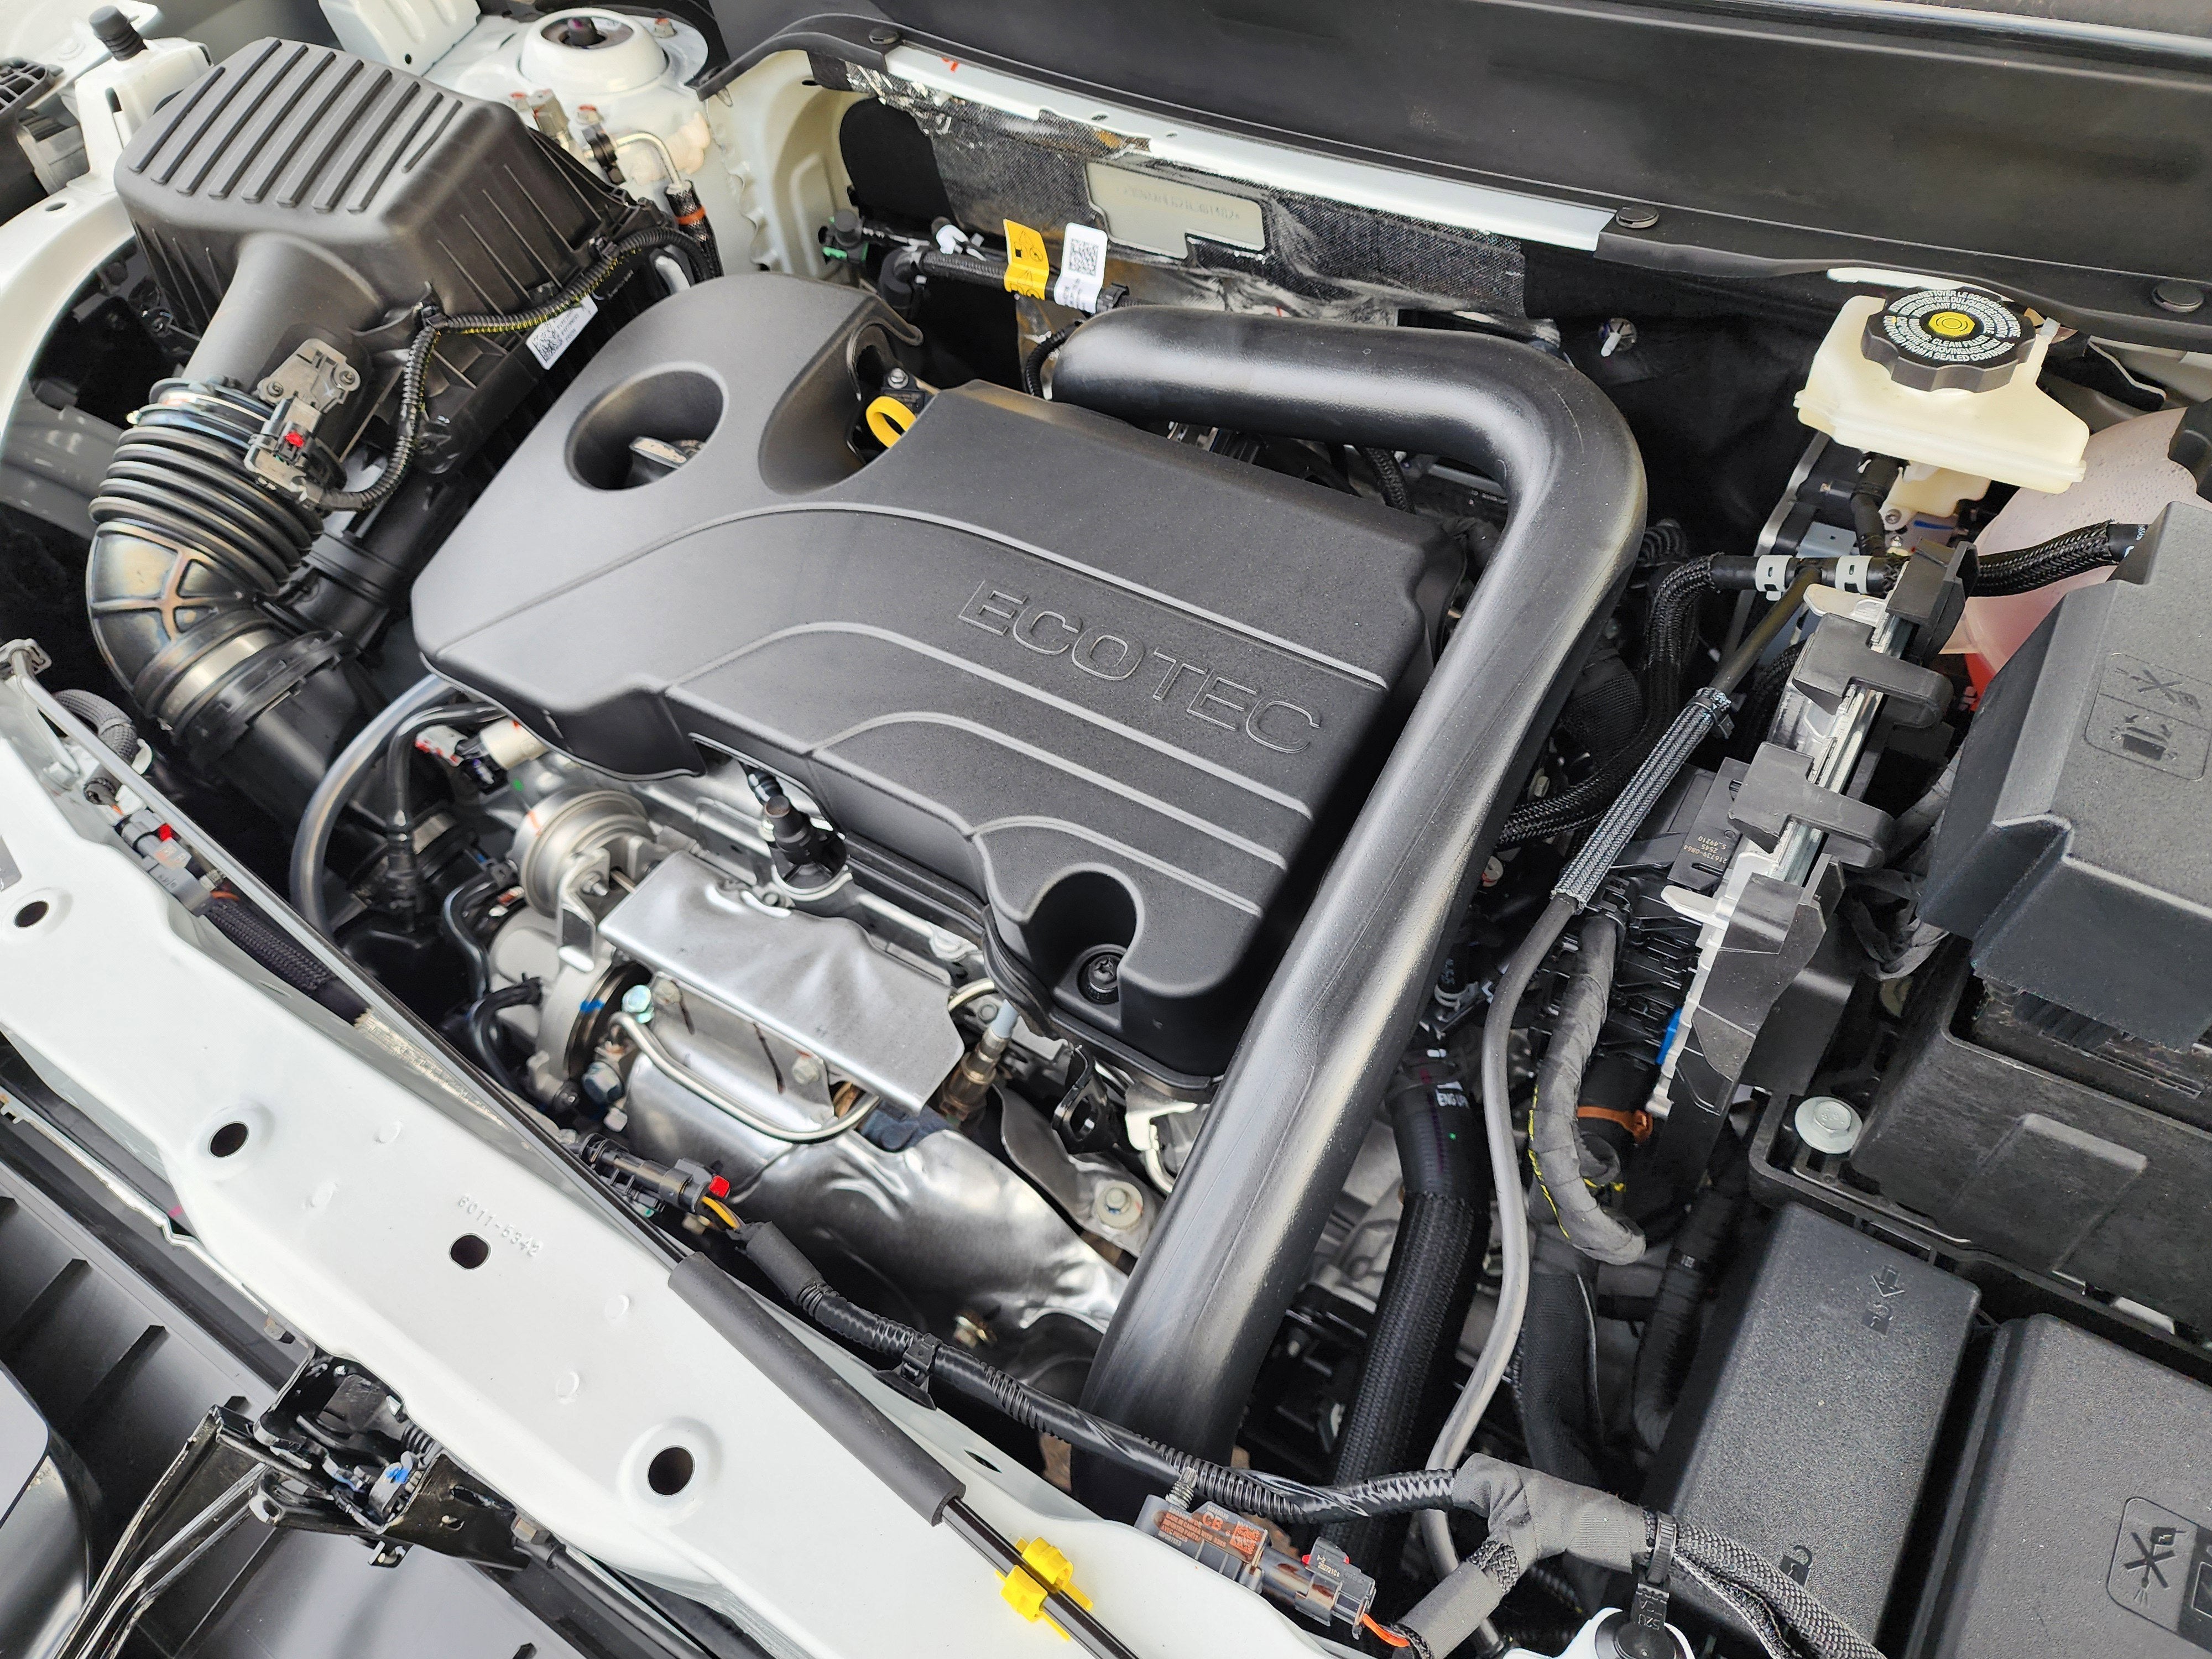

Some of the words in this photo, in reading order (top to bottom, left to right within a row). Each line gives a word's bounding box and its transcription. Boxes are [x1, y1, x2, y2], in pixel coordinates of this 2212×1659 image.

[1932, 338, 1963, 347] CLEAN
[1963, 335, 1990, 347] FILLER
[1969, 346, 1986, 354] USE
[1932, 352, 1970, 361] SEALED
[958, 580, 1321, 754] ECOTEC
[1203, 1511, 1223, 1531] CB
